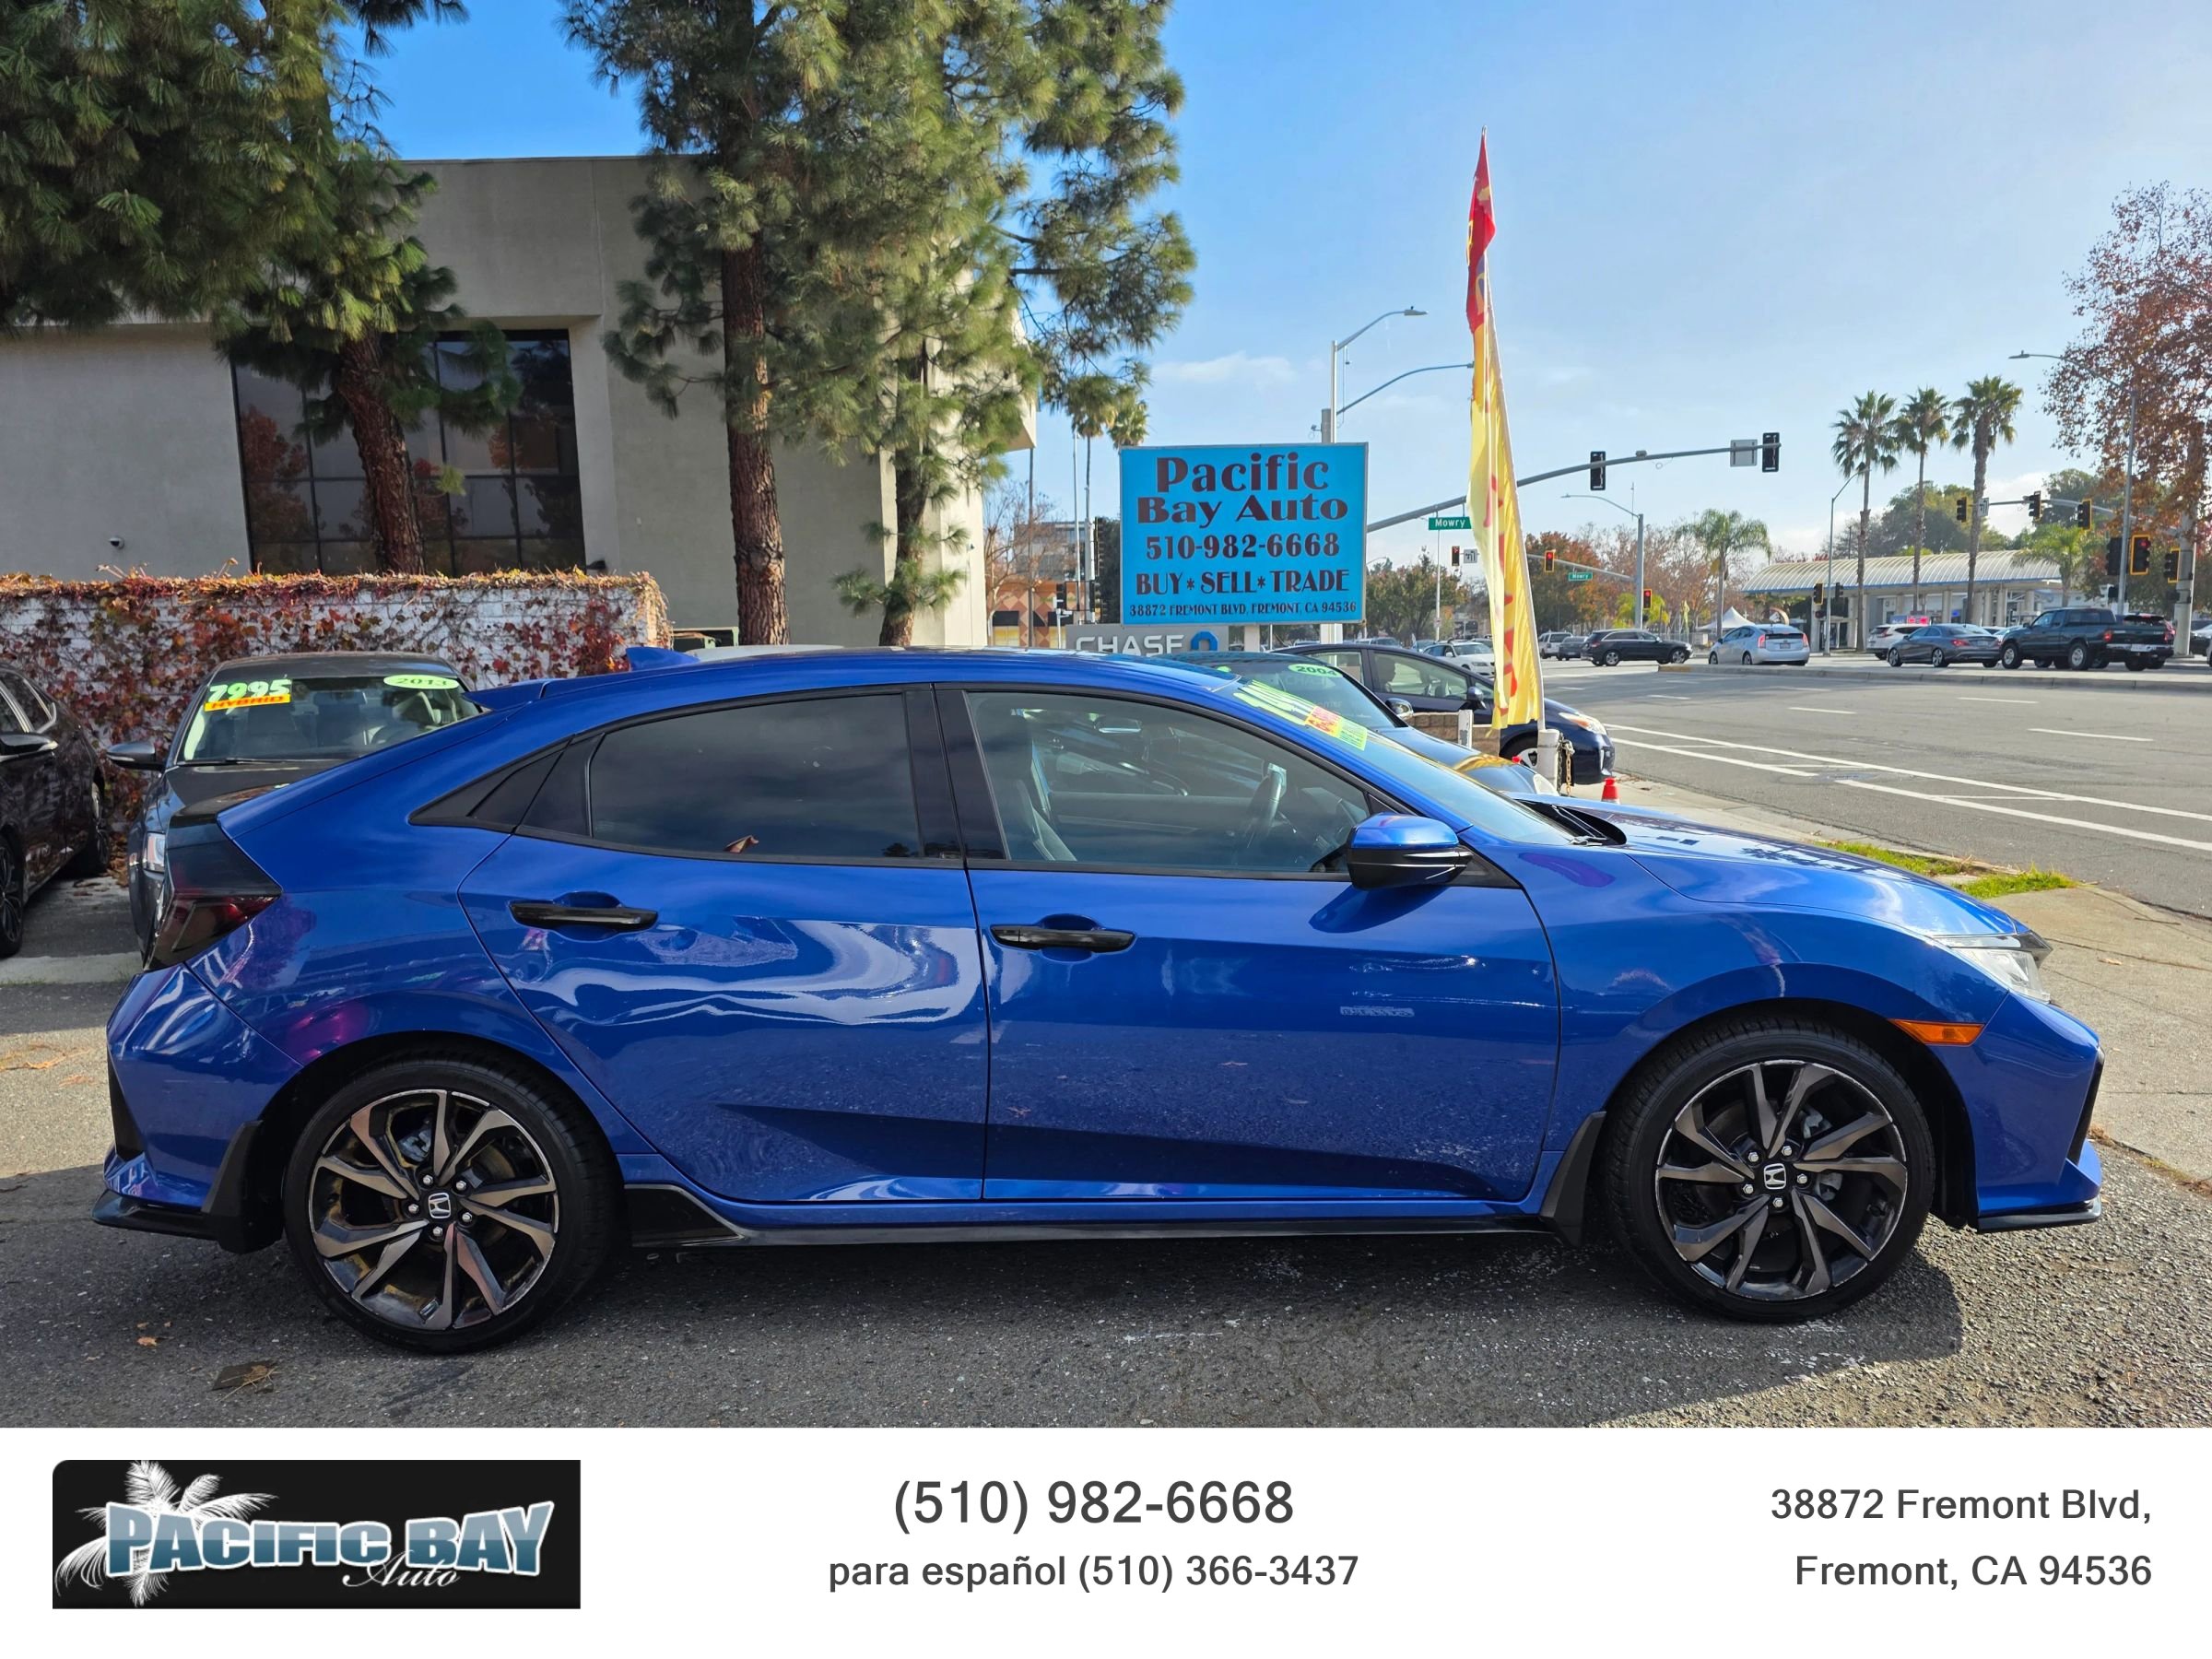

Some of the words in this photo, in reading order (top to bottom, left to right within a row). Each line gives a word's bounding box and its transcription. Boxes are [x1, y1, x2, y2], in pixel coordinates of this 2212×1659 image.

[1157, 452, 1329, 493] Pacific
[1137, 496, 1223, 529] Bay
[1235, 493, 1348, 522] Auto
[1434, 518, 1465, 529] Mowry
[1146, 532, 1340, 560] 510-982-6668
[1136, 572, 1183, 595] BUY
[1200, 570, 1257, 594] SELL
[1269, 569, 1350, 593] TRADE
[1129, 604, 1167, 617] 38872
[1169, 603, 1218, 617] FREMONT
[1304, 600, 1319, 614] CA
[1322, 600, 1358, 614] 94536
[395, 676, 450, 688] 2013
[1295, 665, 1338, 677] 2004
[207, 678, 292, 703] 7995
